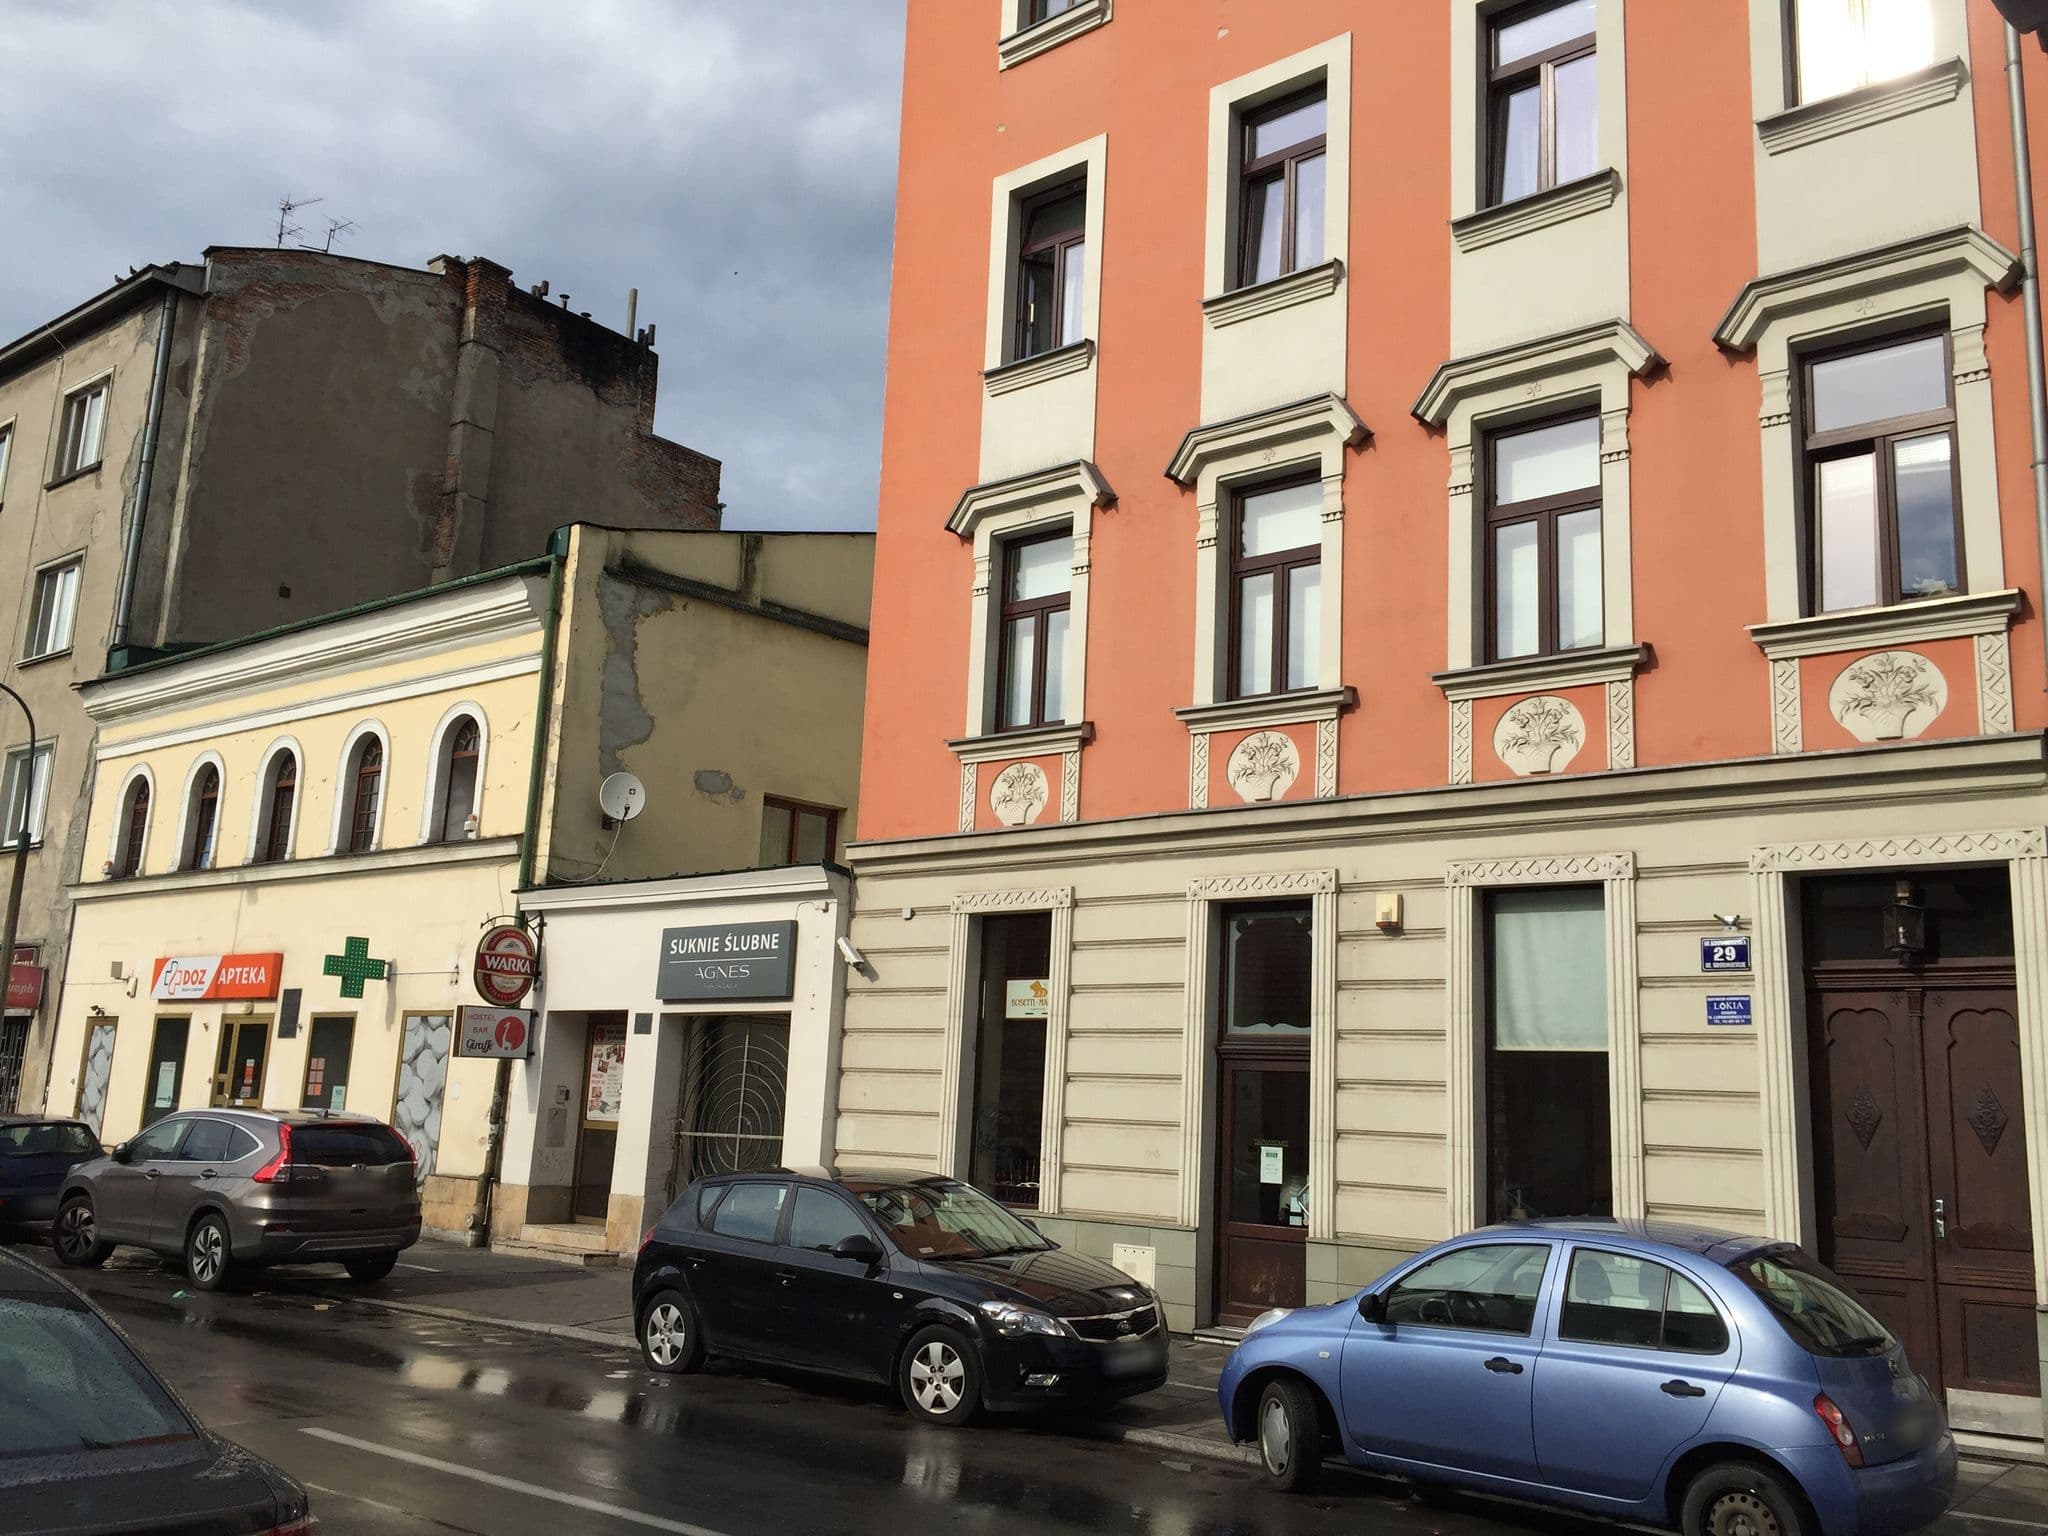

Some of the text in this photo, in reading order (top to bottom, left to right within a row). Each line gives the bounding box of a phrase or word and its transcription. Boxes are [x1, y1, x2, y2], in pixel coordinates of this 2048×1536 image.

[669, 932, 780, 955] SUKNIE ŚLUBNE
[1713, 946, 1736, 962] 29
[484, 955, 531, 973] WARKA
[694, 964, 751, 979] AGNES
[182, 969, 207, 986] DOZ
[217, 966, 266, 985] APTEKA
[468, 1013, 496, 1022] HOSTEL
[473, 1026, 488, 1034] BAR
